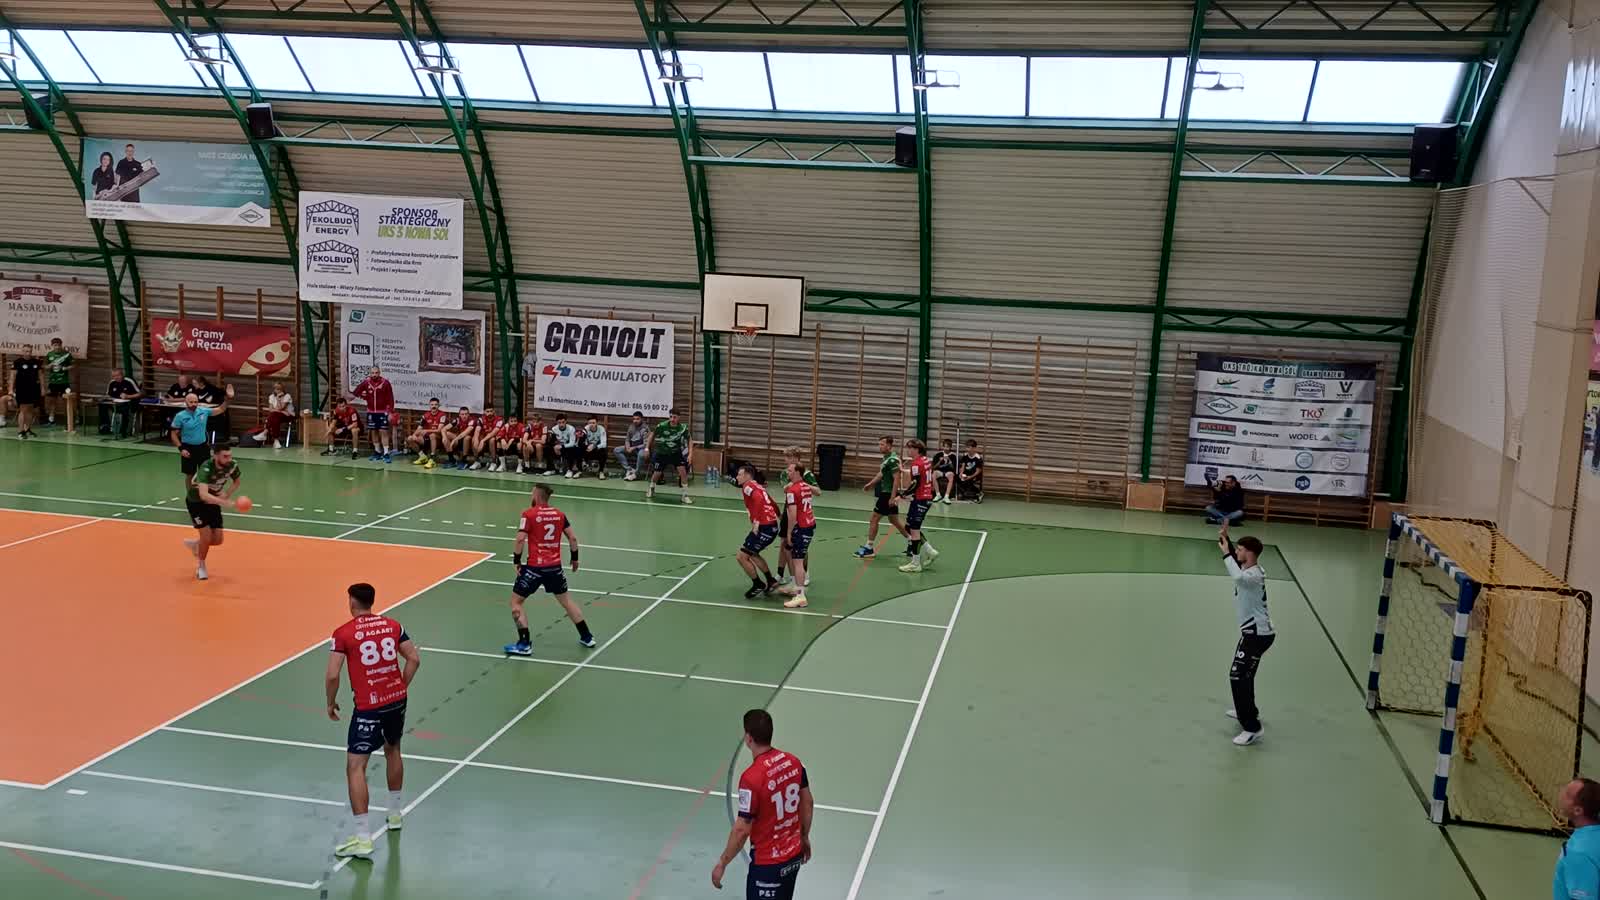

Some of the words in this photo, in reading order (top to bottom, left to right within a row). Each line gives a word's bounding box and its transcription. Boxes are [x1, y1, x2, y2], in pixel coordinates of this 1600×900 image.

[392, 207, 438, 219] SPONSOR
[312, 216, 352, 225] EKOLBUD
[378, 215, 451, 227] STRATEGICZNY
[315, 227, 350, 236] ENERGY
[377, 225, 396, 238] UKS
[396, 226, 404, 239] 3
[405, 226, 432, 240] NOWA
[313, 255, 353, 264] EKOLBUD
[8, 302, 58, 313] MASARNIA
[191, 328, 225, 342] Gramy
[543, 321, 666, 360] GRAVOLT
[186, 340, 195, 348] w
[196, 339, 233, 352] Ręczną
[353, 344, 369, 354] blik
[1222, 361, 1237, 371] UKS
[1264, 364, 1283, 375] NOWA
[574, 368, 667, 384] AKUMULATORY
[547, 396, 583, 405] Ekonomiczna
[590, 400, 606, 408] Nowa
[1289, 433, 1319, 441] WODEL
[1199, 444, 1231, 455] GRAVOLT
[543, 523, 556, 541] 2
[360, 637, 397, 666] 88
[771, 782, 800, 821] 18
